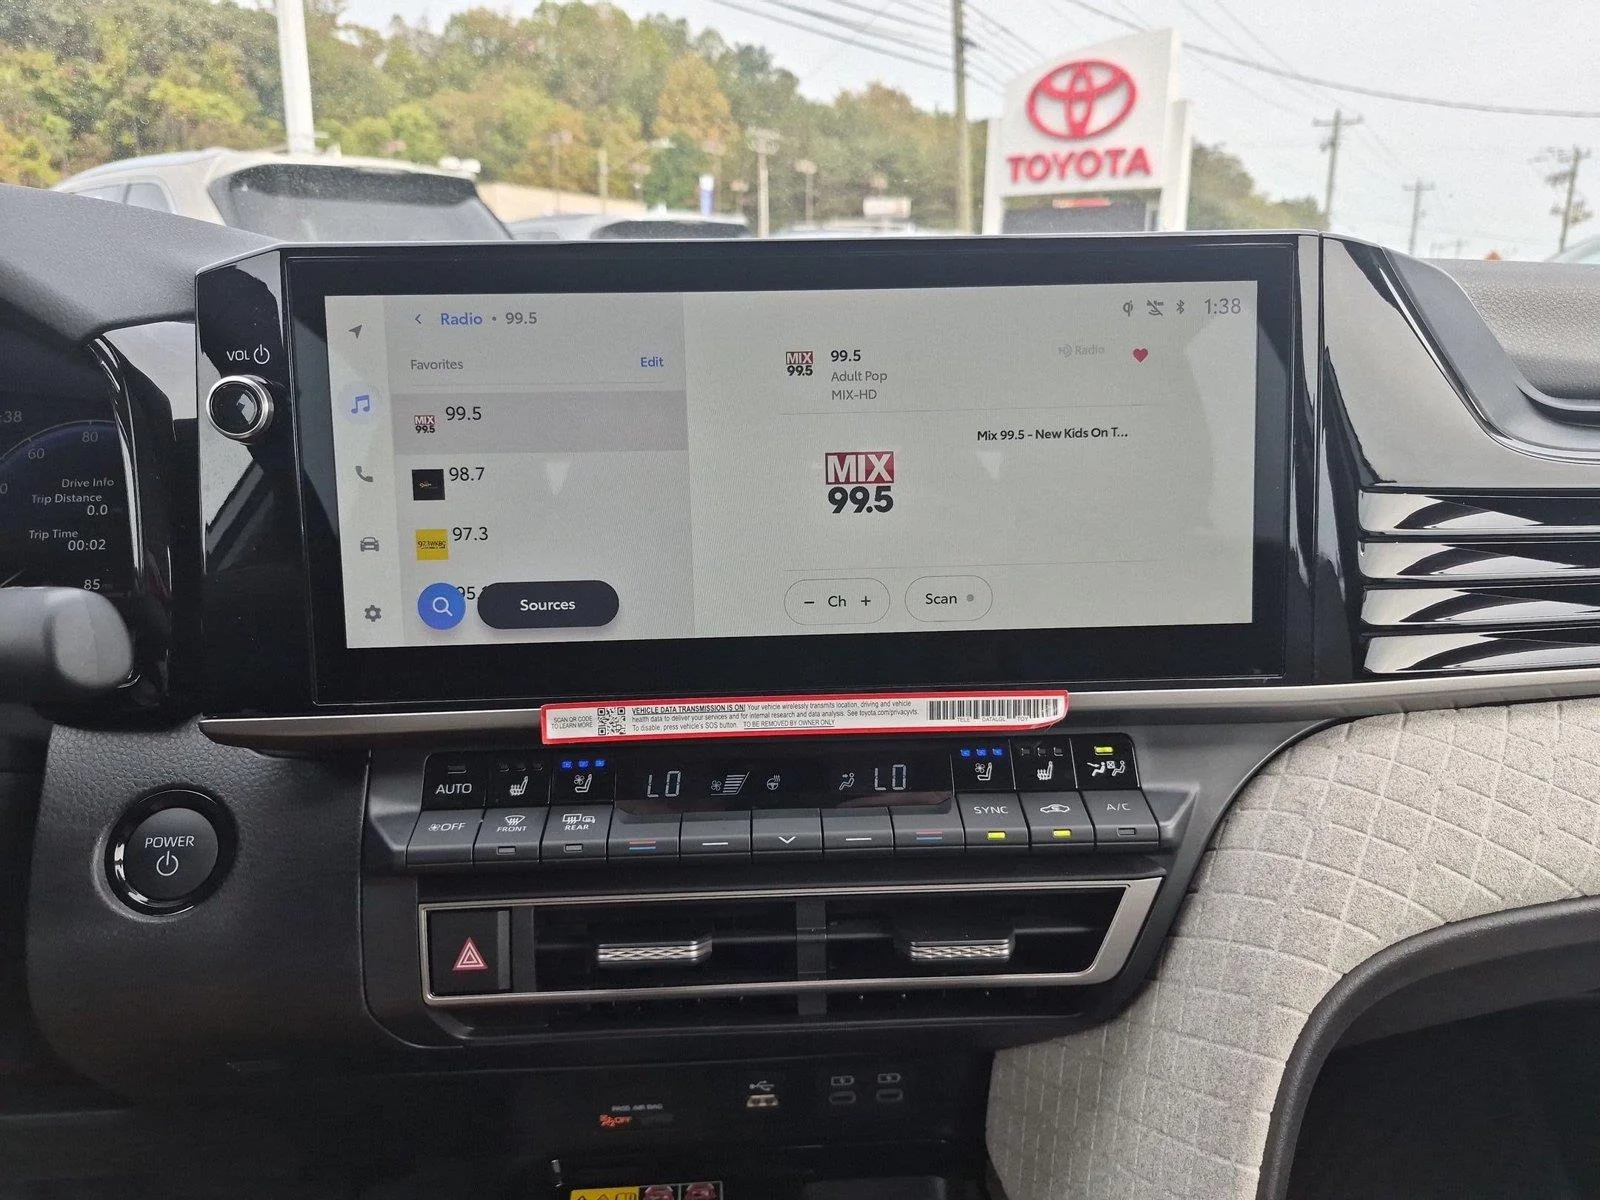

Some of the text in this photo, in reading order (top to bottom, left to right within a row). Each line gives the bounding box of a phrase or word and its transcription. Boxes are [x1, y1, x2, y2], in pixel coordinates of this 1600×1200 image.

[1006, 148, 1153, 184] TOYOTA
[1204, 298, 1241, 314] 1:38
[441, 312, 538, 325] Radio 99.5
[227, 351, 250, 361] VOL
[830, 350, 861, 362] 99.5
[1075, 344, 1105, 356] Radio
[640, 356, 664, 368] Edit
[786, 352, 813, 364] MIX
[410, 359, 464, 371] Favorites
[787, 365, 813, 376] 99.5
[831, 371, 888, 383] Adult Pop
[832, 389, 877, 400] MIX-HD
[445, 406, 482, 421] 99.5
[414, 415, 435, 425] MIX
[415, 425, 436, 433] 99.5
[977, 430, 998, 441] Mix
[1000, 430, 1025, 440] 99.5
[1035, 429, 1062, 440] New
[1064, 428, 1088, 439] Kids
[1091, 427, 1108, 438] On
[82, 431, 98, 443] 80
[28, 448, 45, 459] 60
[449, 467, 485, 481] 98.7
[827, 453, 893, 483] MIX
[62, 477, 114, 488] Drive Info
[32, 494, 102, 505] Trip Distance
[827, 486, 894, 514] 99.5
[86, 505, 108, 516] 0.0
[29, 529, 79, 540] Trip Time
[452, 526, 488, 541] 97.3
[67, 539, 106, 551] 00:02
[84, 578, 100, 590] 85
[519, 598, 576, 611] Sources
[827, 595, 847, 607] Ch
[925, 593, 958, 605] Scan
[631, 706, 659, 714] VEHICLE
[677, 704, 726, 713] TRANSMISSION
[435, 783, 473, 795] AUTO
[973, 805, 1009, 815] SYNC
[1106, 803, 1131, 812] A/C
[440, 822, 466, 831] OFF
[144, 835, 195, 848] POWER
